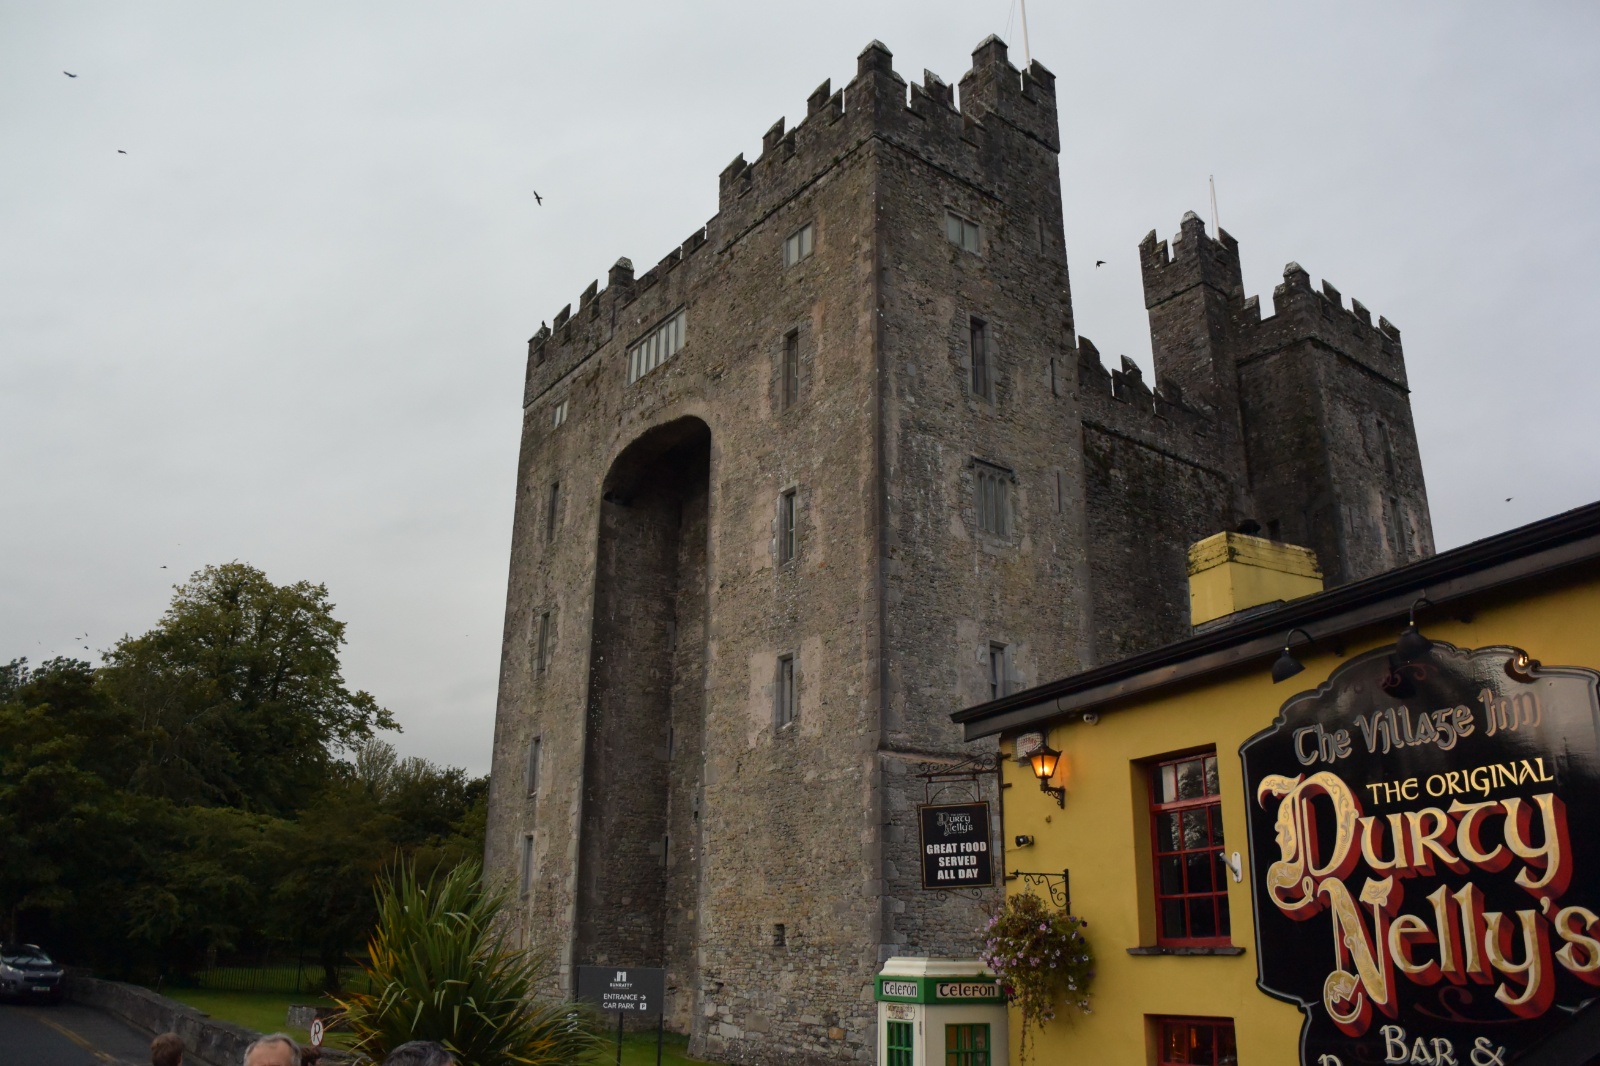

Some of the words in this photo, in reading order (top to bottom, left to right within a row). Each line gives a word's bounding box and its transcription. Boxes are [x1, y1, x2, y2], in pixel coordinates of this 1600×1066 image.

[1293, 722, 1352, 765] The
[1353, 703, 1475, 753] Village
[1477, 688, 1542, 736] Inn
[1366, 777, 1420, 805] THE
[1425, 757, 1554, 798] ORIGINAL
[926, 843, 958, 855] GREAT
[960, 841, 987, 853] FOOD
[938, 855, 977, 867] SERVED
[937, 869, 956, 880] ALL
[958, 868, 979, 879] DAY
[1316, 875, 1600, 1024] Nelly's
[603, 993, 638, 1001] ENTRANCE
[602, 1001, 617, 1009] CAR
[617, 1002, 635, 1010] PARK
[1469, 1036, 1506, 1066] &
